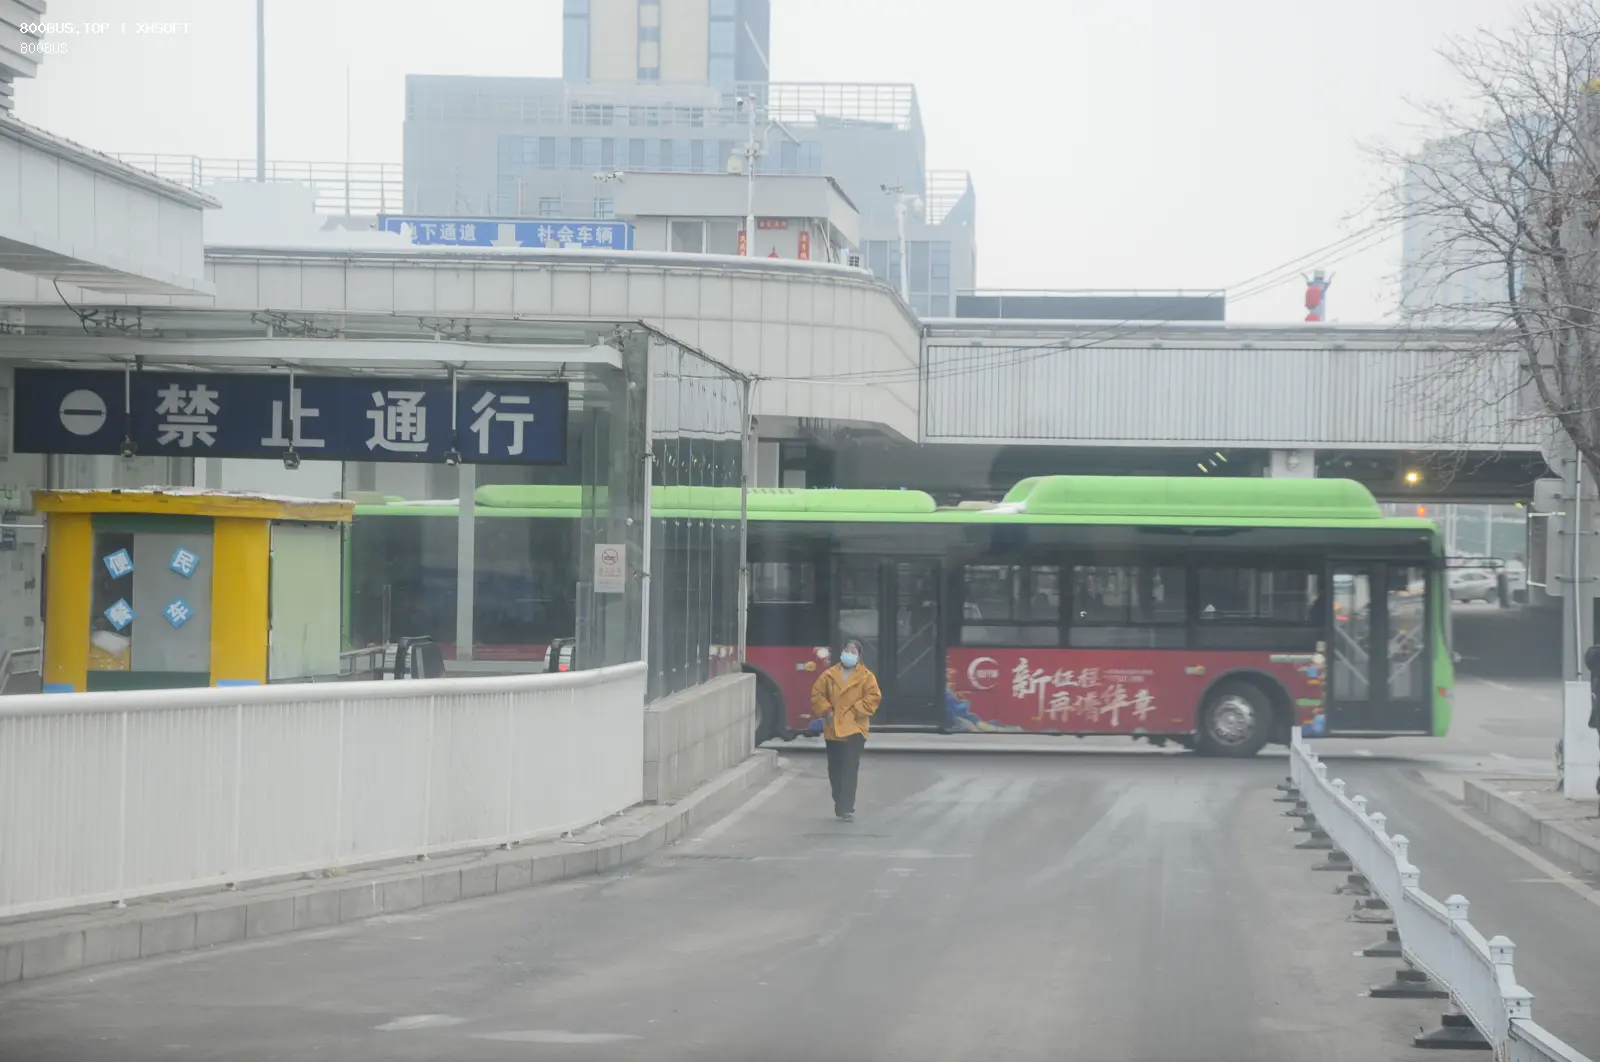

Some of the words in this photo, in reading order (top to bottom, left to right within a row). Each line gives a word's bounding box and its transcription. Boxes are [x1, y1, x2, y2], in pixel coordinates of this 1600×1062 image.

[537, 225, 613, 244] 社会车辆
[154, 383, 535, 456] 禁止通行
